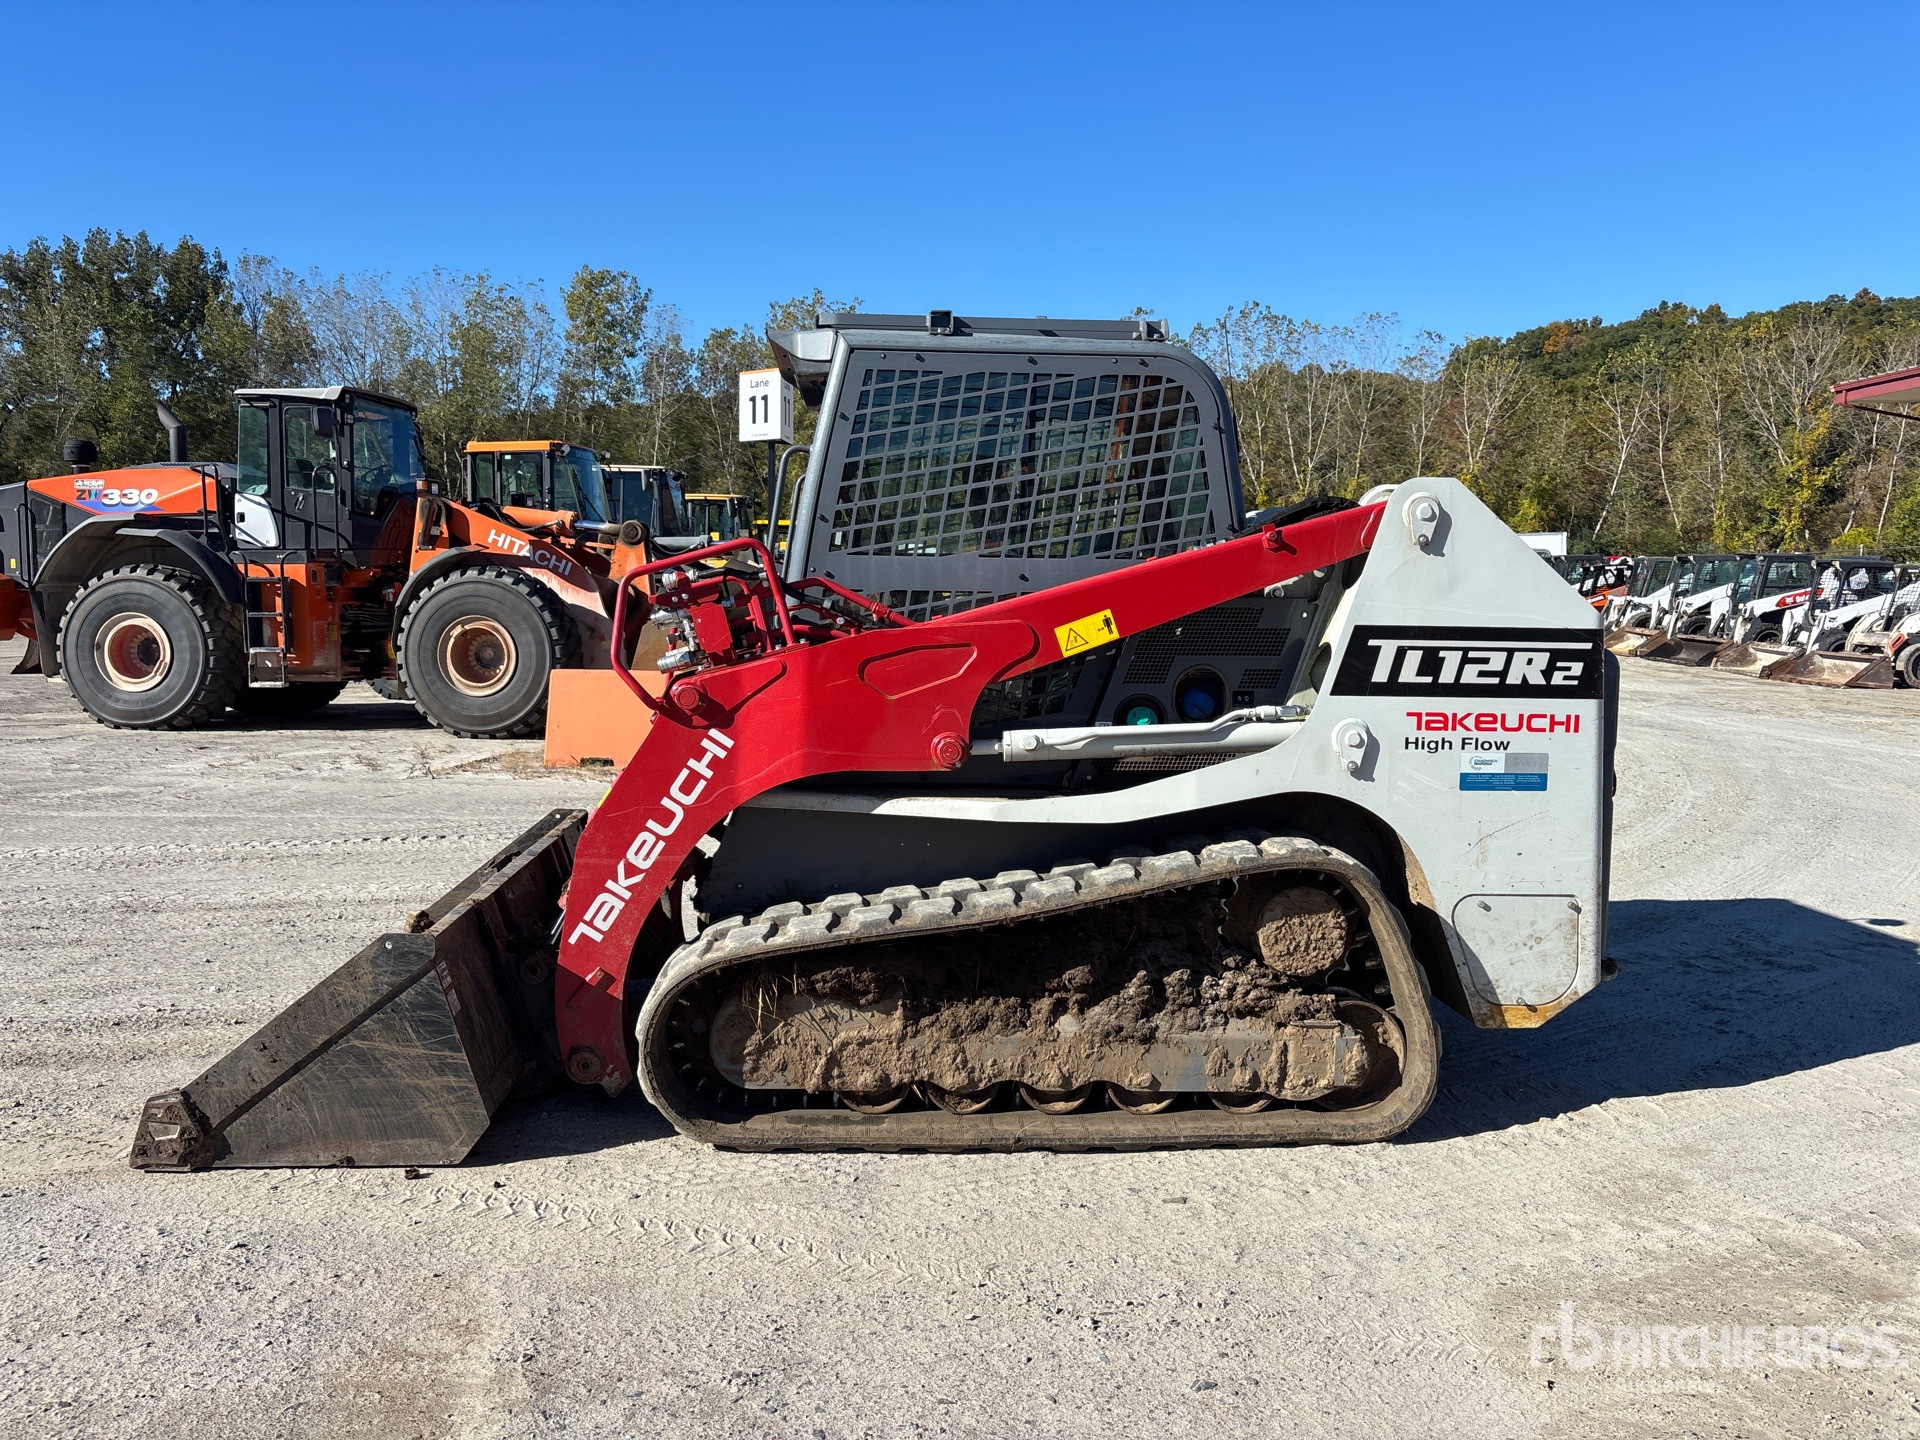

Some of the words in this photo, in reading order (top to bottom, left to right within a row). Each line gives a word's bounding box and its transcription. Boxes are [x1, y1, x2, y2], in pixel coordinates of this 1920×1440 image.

[750, 379, 769, 388] Lane
[749, 394, 768, 424] 11
[784, 396, 791, 427] 11
[487, 528, 573, 576] HITACHI
[1367, 639, 1593, 686] TL12R2
[1405, 737, 1453, 754] High
[1460, 737, 1511, 751] Flow
